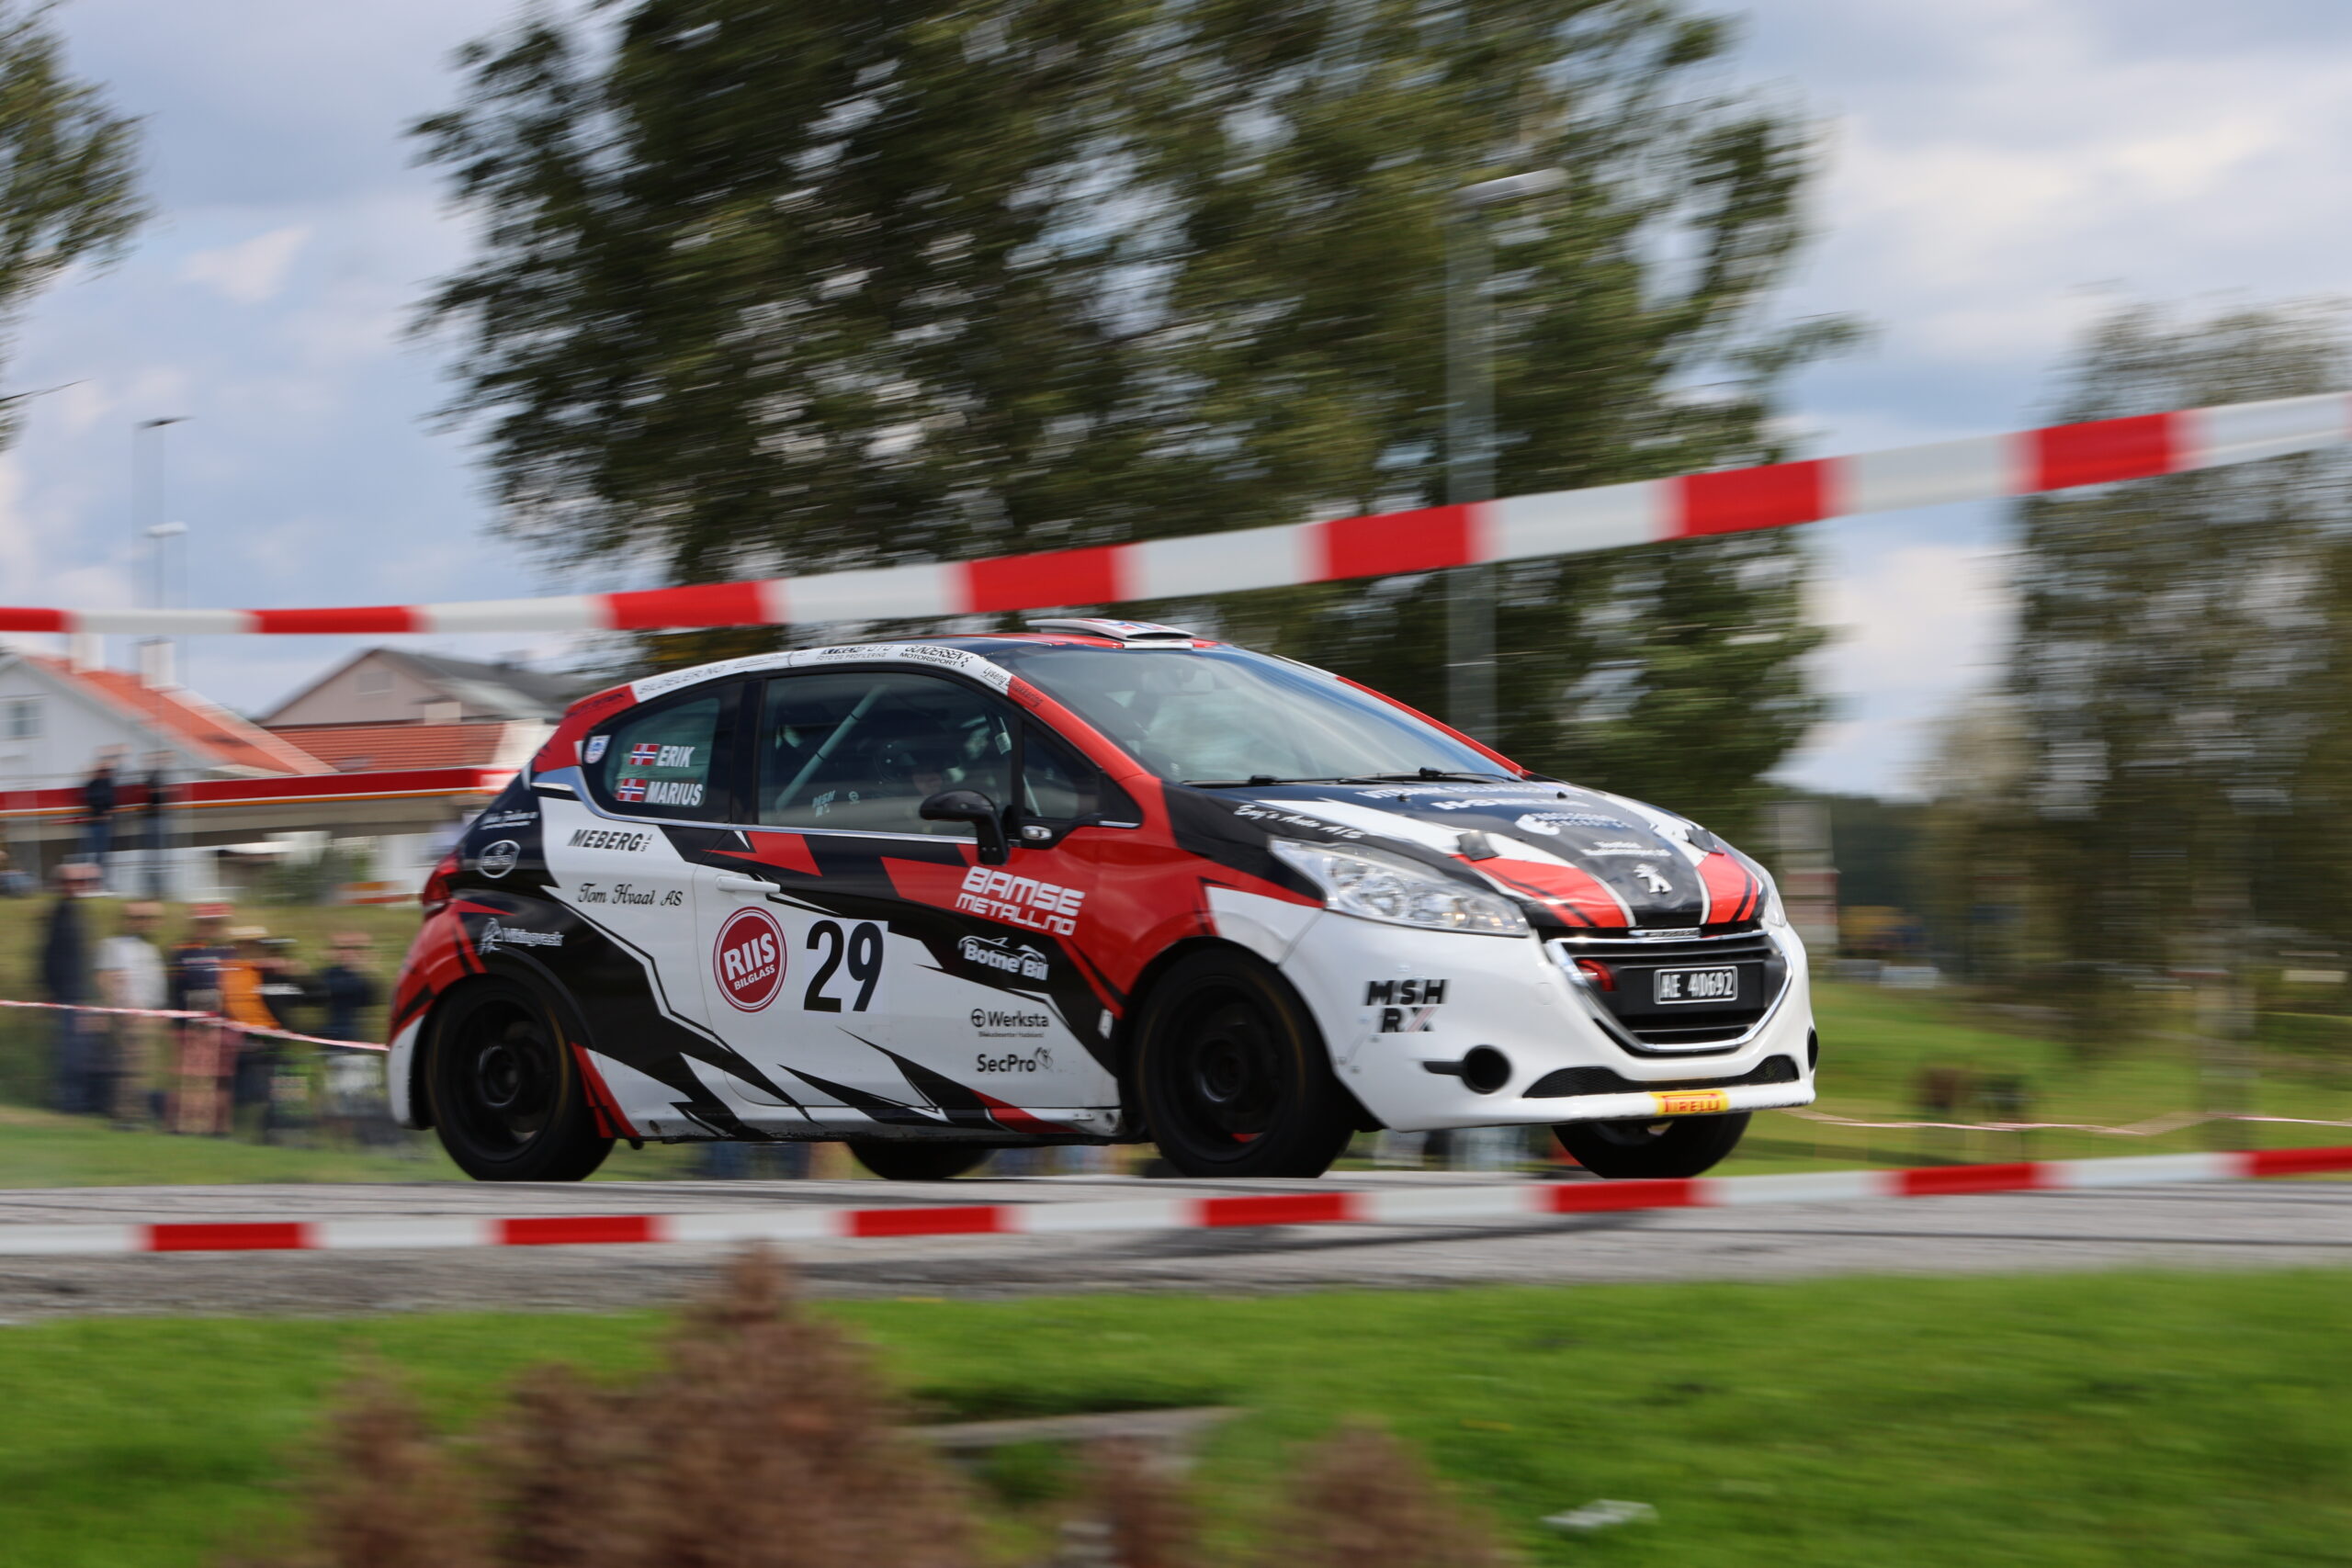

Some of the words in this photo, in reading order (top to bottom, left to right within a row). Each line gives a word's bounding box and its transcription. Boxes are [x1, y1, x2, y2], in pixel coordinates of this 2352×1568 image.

[899, 651, 959, 667] MOTORSPORT
[656, 745, 695, 768] ERIK
[645, 781, 704, 807] MARIUS
[567, 829, 644, 852] MEBERG
[577, 882, 608, 904] Tom
[612, 883, 656, 906] Hvaal
[660, 889, 684, 907] AS
[961, 865, 1086, 917] BAMSE
[956, 893, 1077, 936] METALL.NO
[723, 932, 776, 981] RIIS
[804, 919, 884, 1013] 29
[964, 942, 1021, 974] Botne
[1022, 959, 1049, 981] Bil
[734, 964, 776, 991] BILGLASS
[1660, 974, 1681, 998] AE
[1687, 971, 1734, 998] 40692
[1363, 978, 1451, 1006] MSH
[987, 1010, 1049, 1028] Werksta
[977, 1053, 1037, 1073] SecPro
